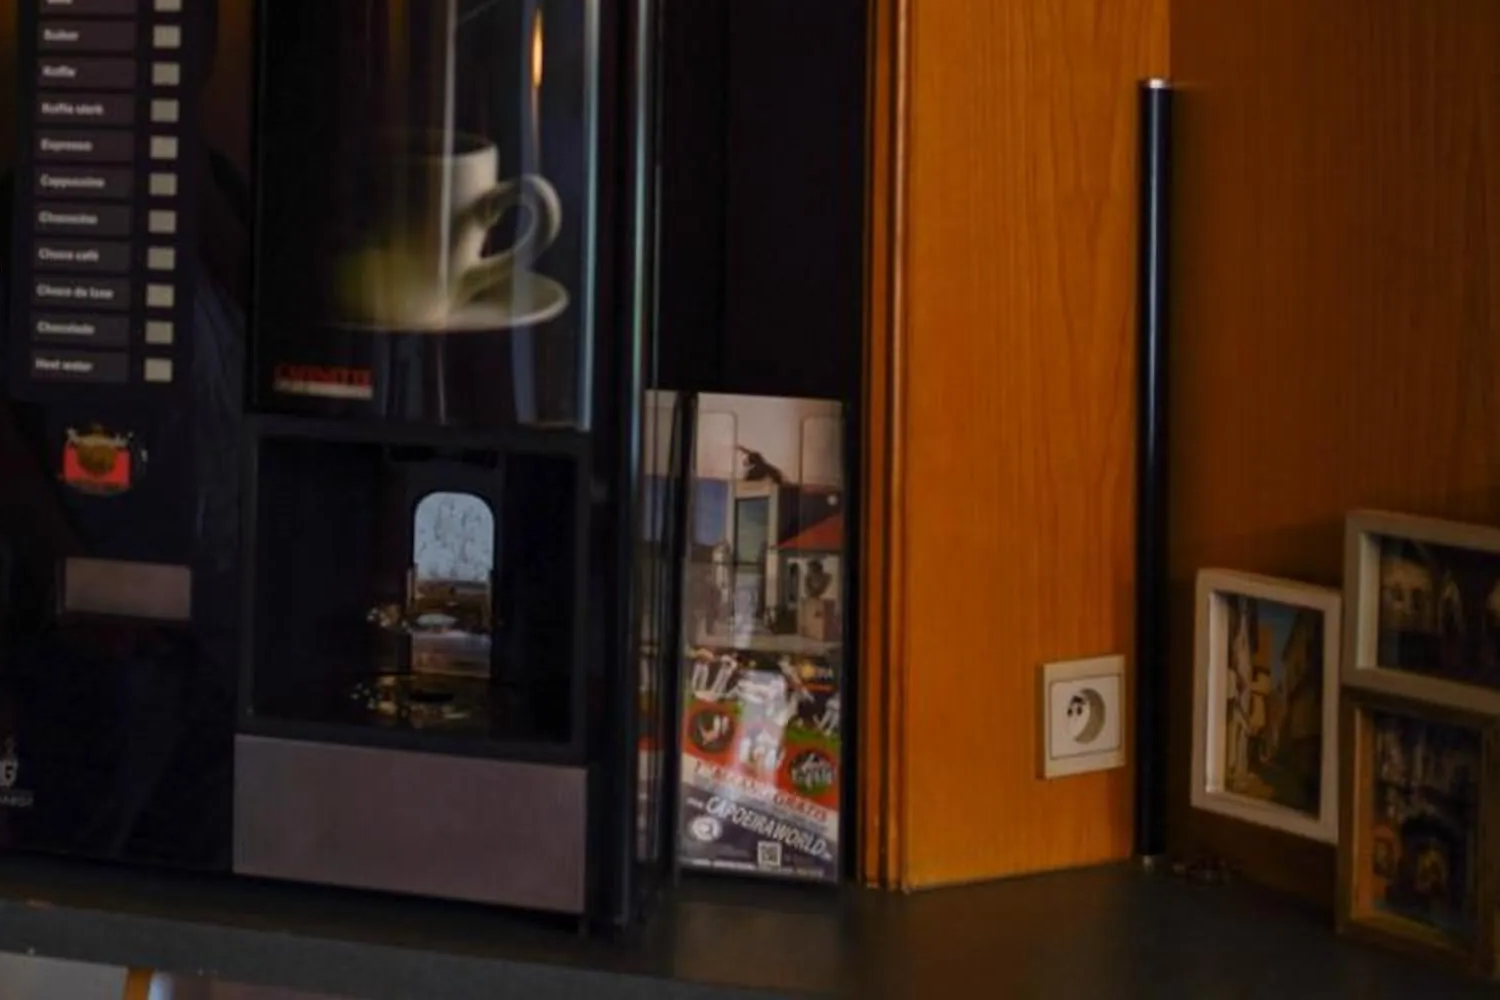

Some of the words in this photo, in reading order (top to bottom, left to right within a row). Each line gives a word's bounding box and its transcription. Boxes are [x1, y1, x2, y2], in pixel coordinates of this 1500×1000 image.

[43, 29, 79, 41] Suiker
[42, 65, 77, 78] Koffie
[41, 102, 74, 115] Koffie
[40, 138, 93, 152] Espresso
[35, 283, 72, 297] Choco
